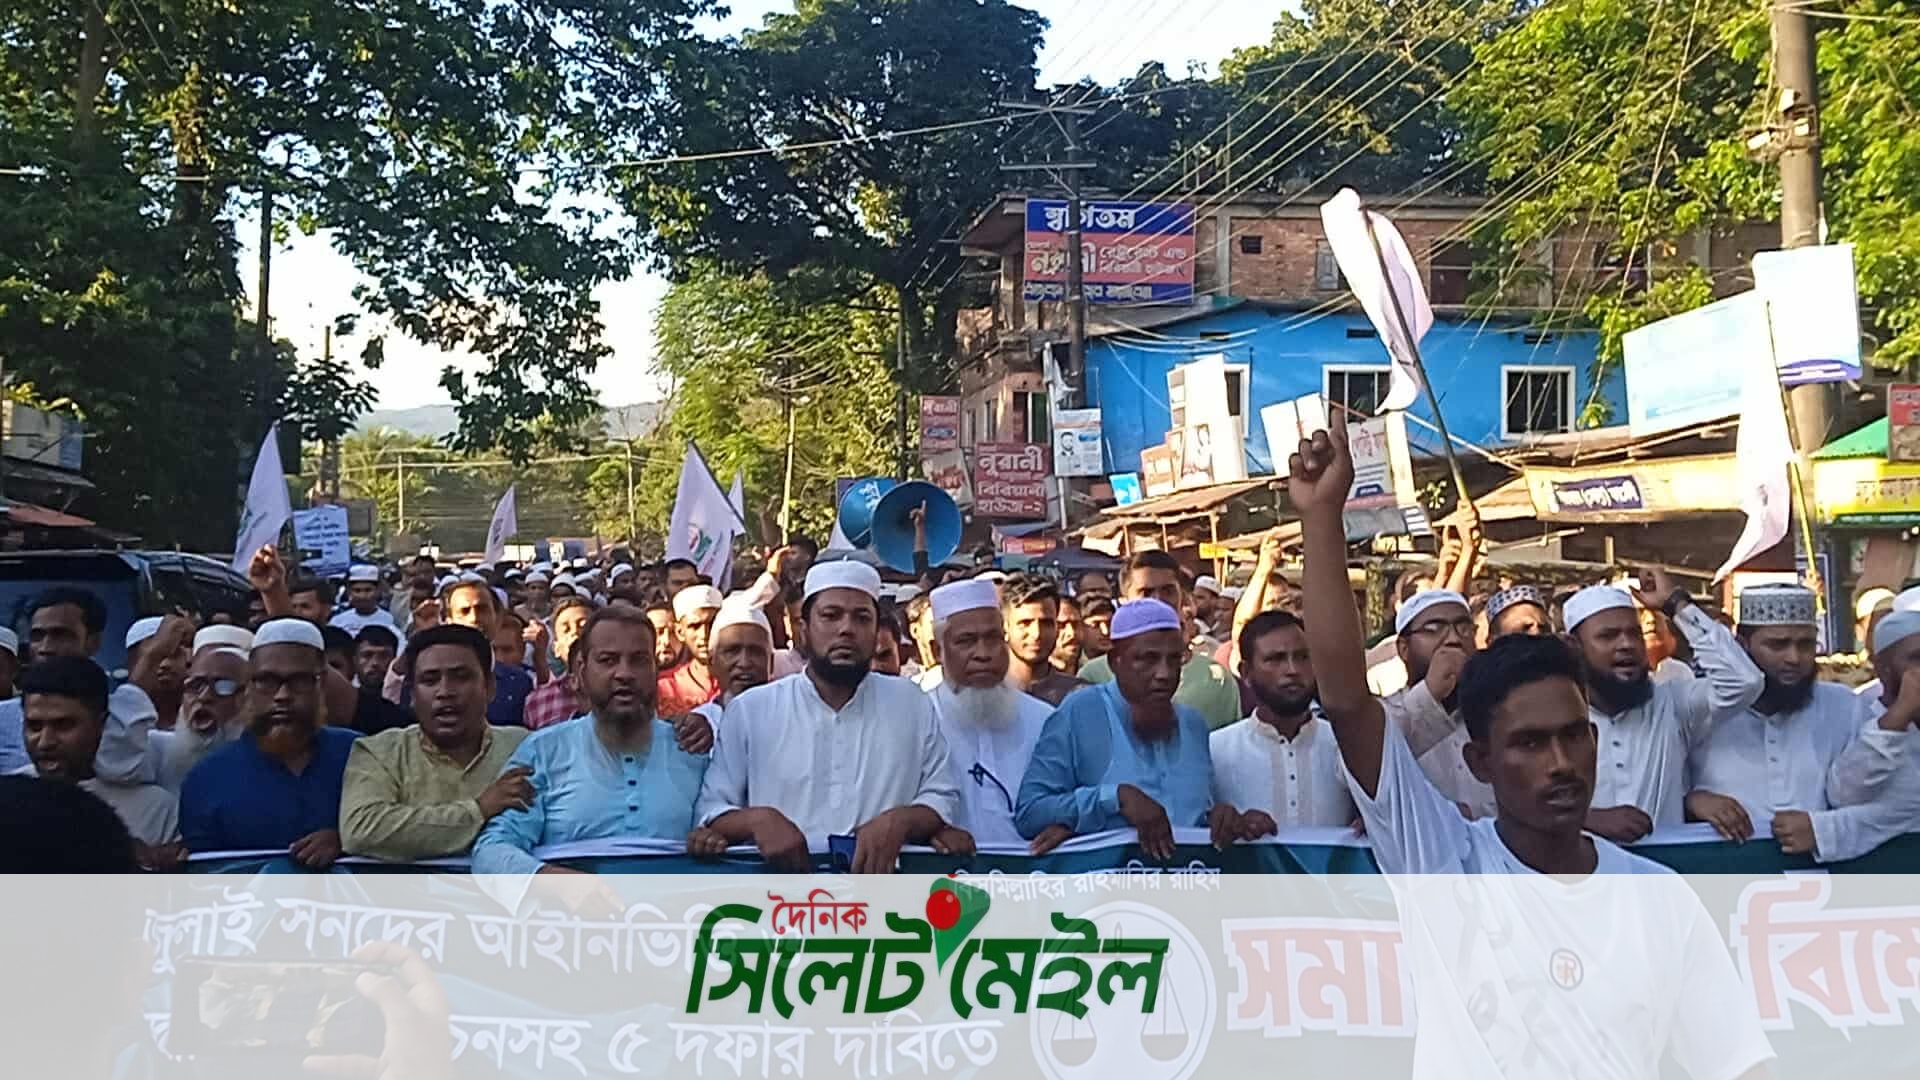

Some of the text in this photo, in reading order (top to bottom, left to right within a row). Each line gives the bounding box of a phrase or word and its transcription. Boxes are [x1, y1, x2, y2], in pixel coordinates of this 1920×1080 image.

[979, 445, 1043, 476] নূরানী
[1167, 860, 1221, 892] রাহিম
[144, 886, 263, 975] জুলাই
[274, 898, 456, 965] সনদের
[608, 1022, 650, 1073] ৫
[667, 1019, 815, 1080] দফার
[825, 1008, 1005, 1079] দাবিতে
